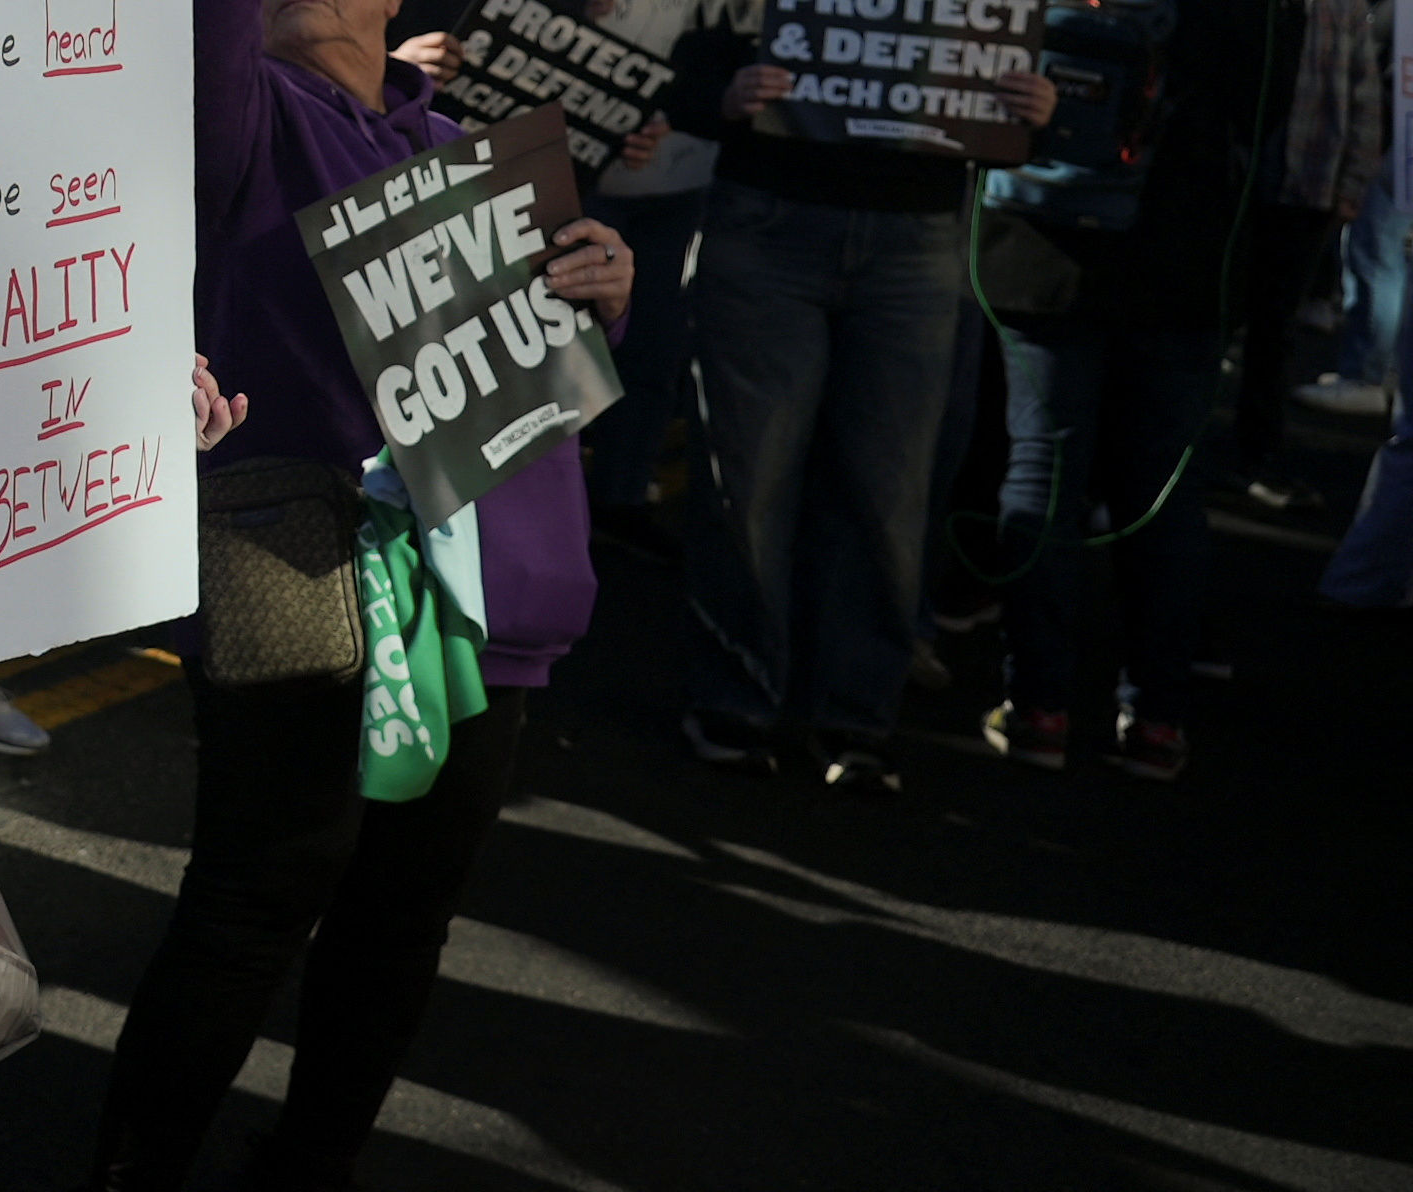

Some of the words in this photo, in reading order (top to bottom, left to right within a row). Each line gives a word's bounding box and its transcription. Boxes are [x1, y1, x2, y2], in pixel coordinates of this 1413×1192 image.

[769, 21, 814, 63] &
[821, 26, 1033, 82] DEFEND
[444, 74, 516, 120] ACH
[486, 44, 643, 135] DEFEND
[782, 72, 884, 110] ACH
[887, 82, 1021, 124] OTHE
[49, 164, 119, 215] seen
[341, 182, 547, 343] WE'VE
[375, 315, 500, 447] GOT
[488, 274, 595, 370] US.
[41, 374, 93, 430] IN
